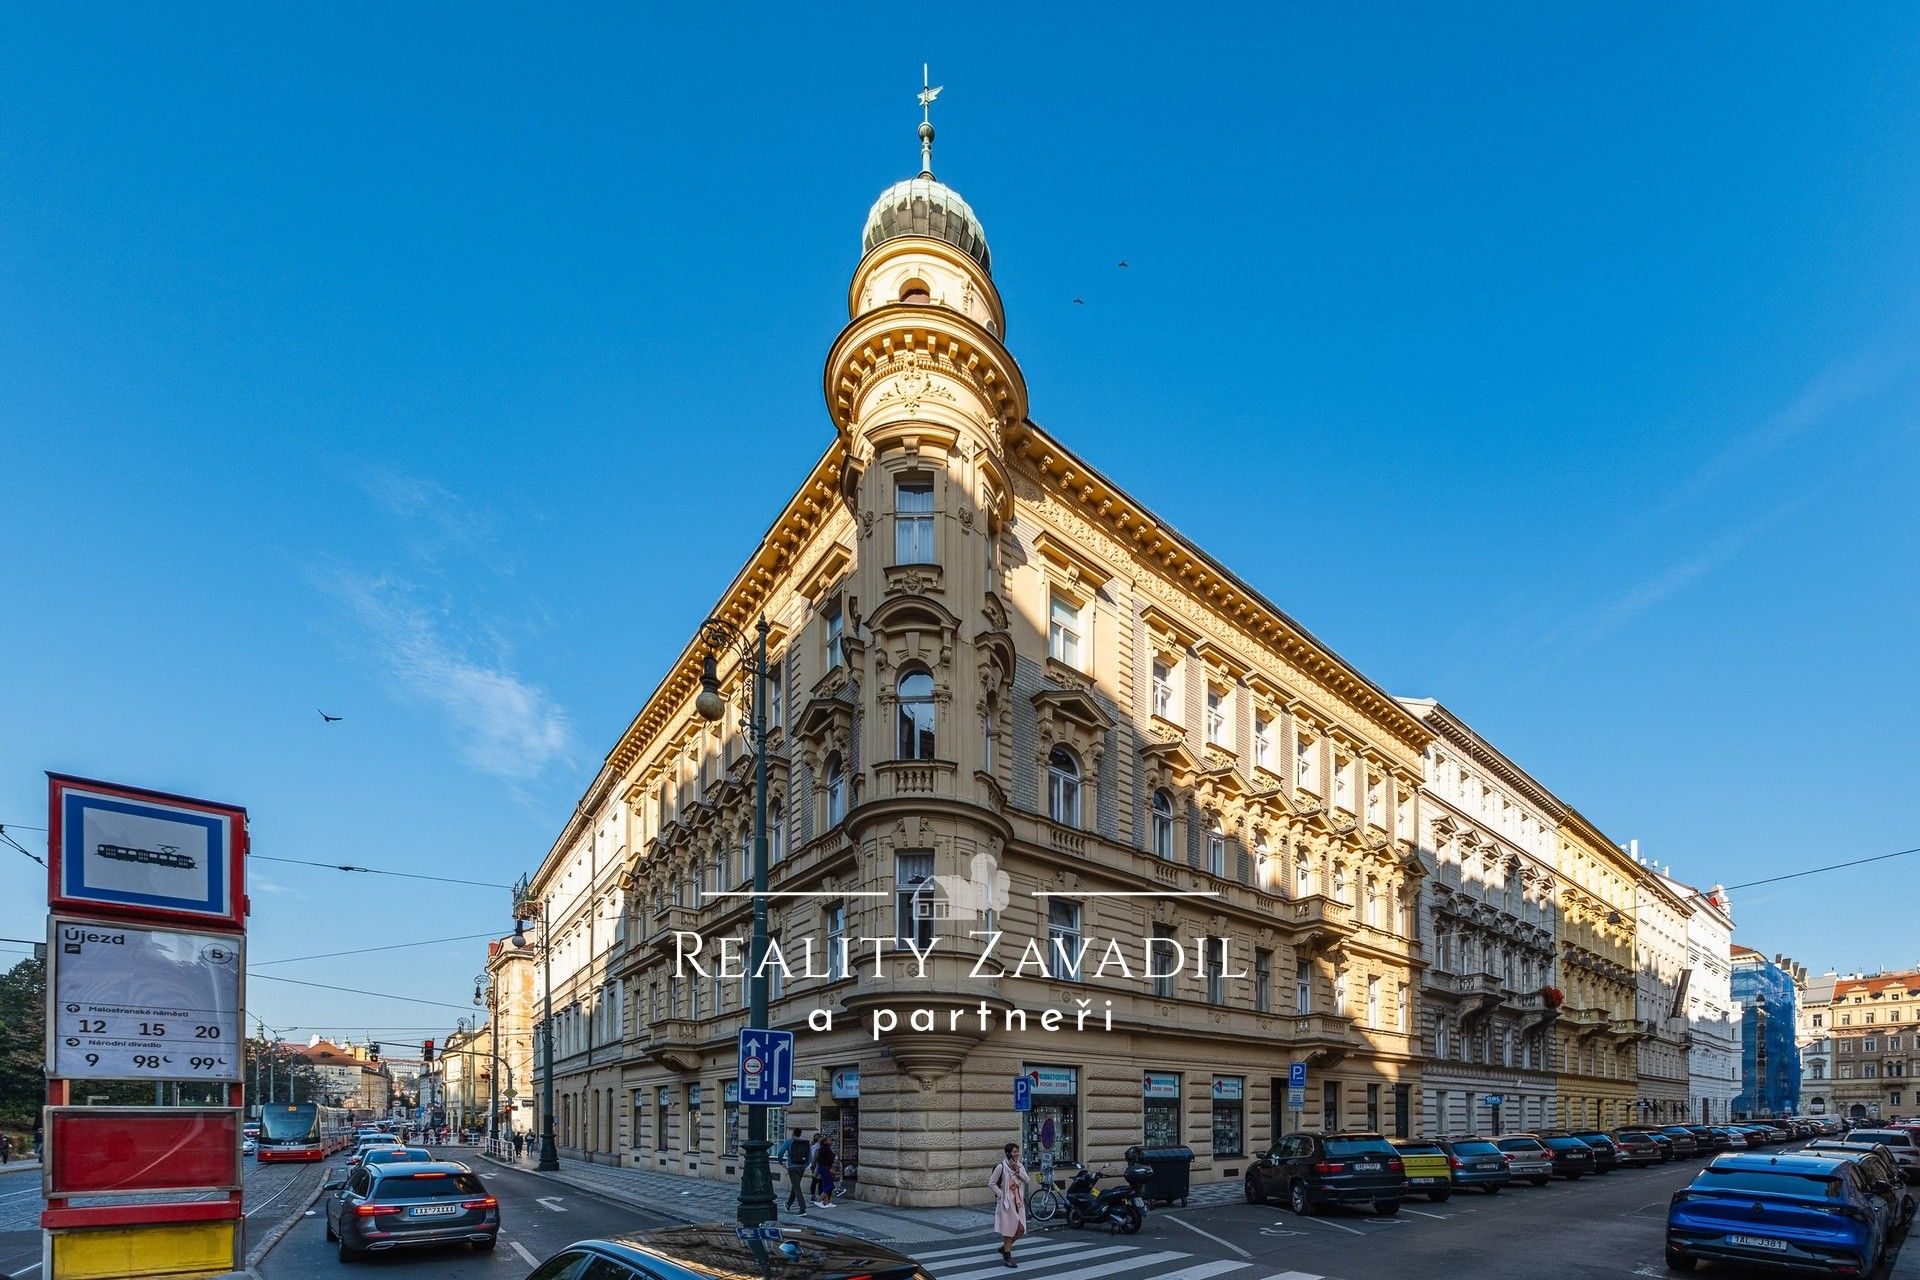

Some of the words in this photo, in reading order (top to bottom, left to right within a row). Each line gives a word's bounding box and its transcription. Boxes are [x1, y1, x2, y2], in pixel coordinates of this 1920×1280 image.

[64, 928, 125, 945] Újezd
[88, 1006, 150, 1015] Malostranské
[153, 1010, 189, 1018] náměstí
[79, 1019, 107, 1034] 12
[139, 1022, 165, 1037] 15
[195, 1025, 220, 1039] 20
[88, 1039, 126, 1047] Národní
[85, 1053, 99, 1067] 9
[133, 1055, 160, 1069] 98
[189, 1056, 215, 1070] 99
[1292, 1066, 1303, 1080] P
[1017, 1081, 1027, 1101] P
